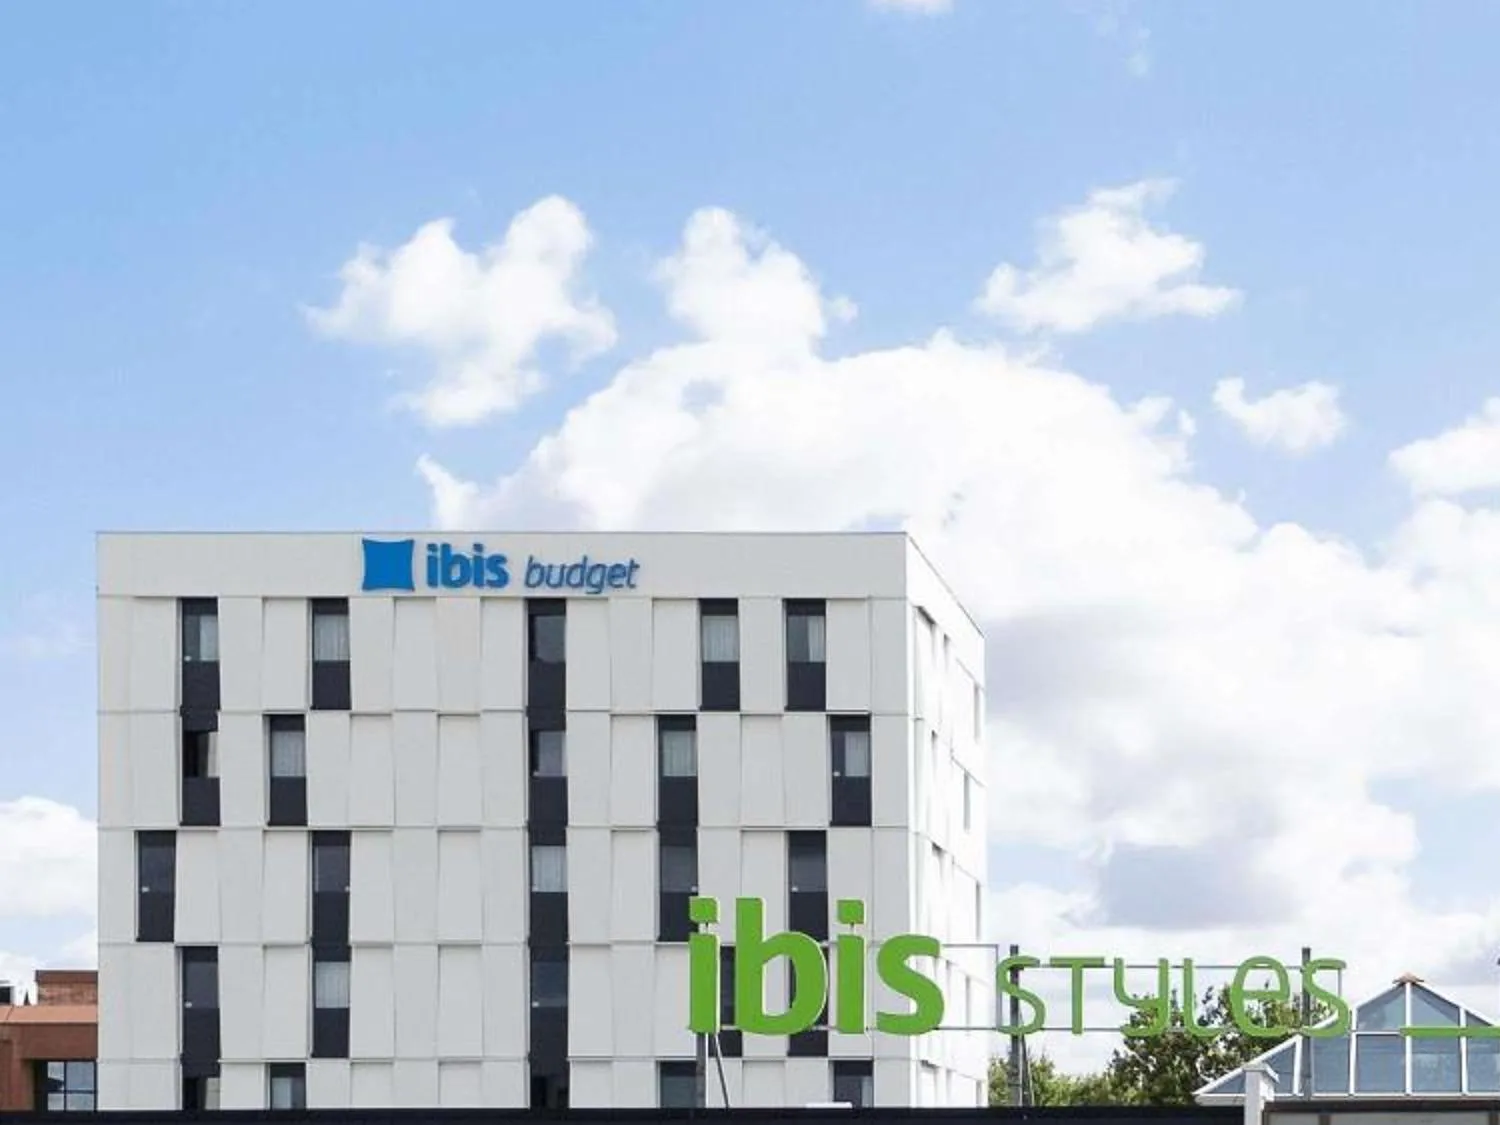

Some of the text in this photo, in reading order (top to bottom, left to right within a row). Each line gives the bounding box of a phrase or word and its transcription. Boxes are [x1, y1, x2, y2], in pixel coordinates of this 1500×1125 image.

[426, 543, 640, 594] ibis budget
[689, 896, 946, 1035] ibis
